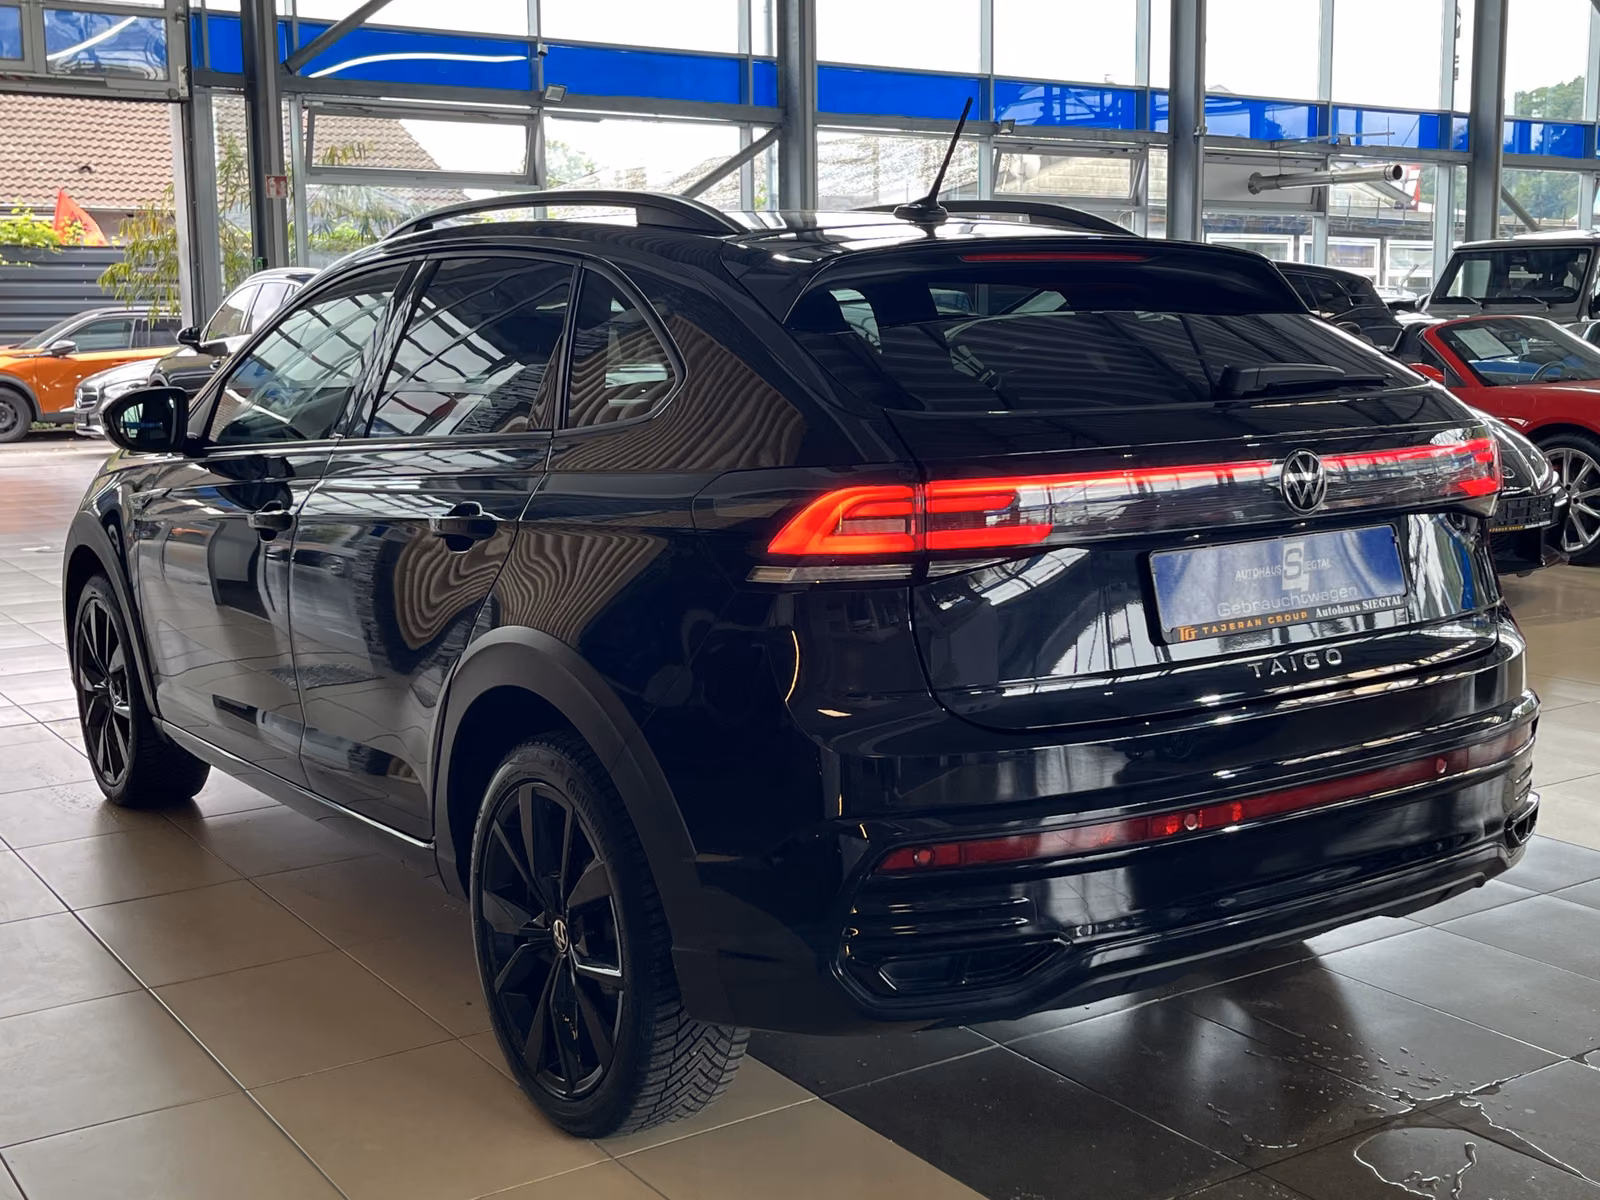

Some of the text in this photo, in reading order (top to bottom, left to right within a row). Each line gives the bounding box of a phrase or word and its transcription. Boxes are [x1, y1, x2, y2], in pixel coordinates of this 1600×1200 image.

[1235, 564, 1282, 581] AUTOHAUS
[1201, 618, 1262, 635] TAJERAN
[1267, 611, 1308, 624] GROUP
[1315, 603, 1361, 618] Autohaus
[1362, 595, 1404, 611] SIEGTAL
[1216, 585, 1358, 617] Gebrauchtwagen
[1247, 648, 1343, 678] TAIGO
